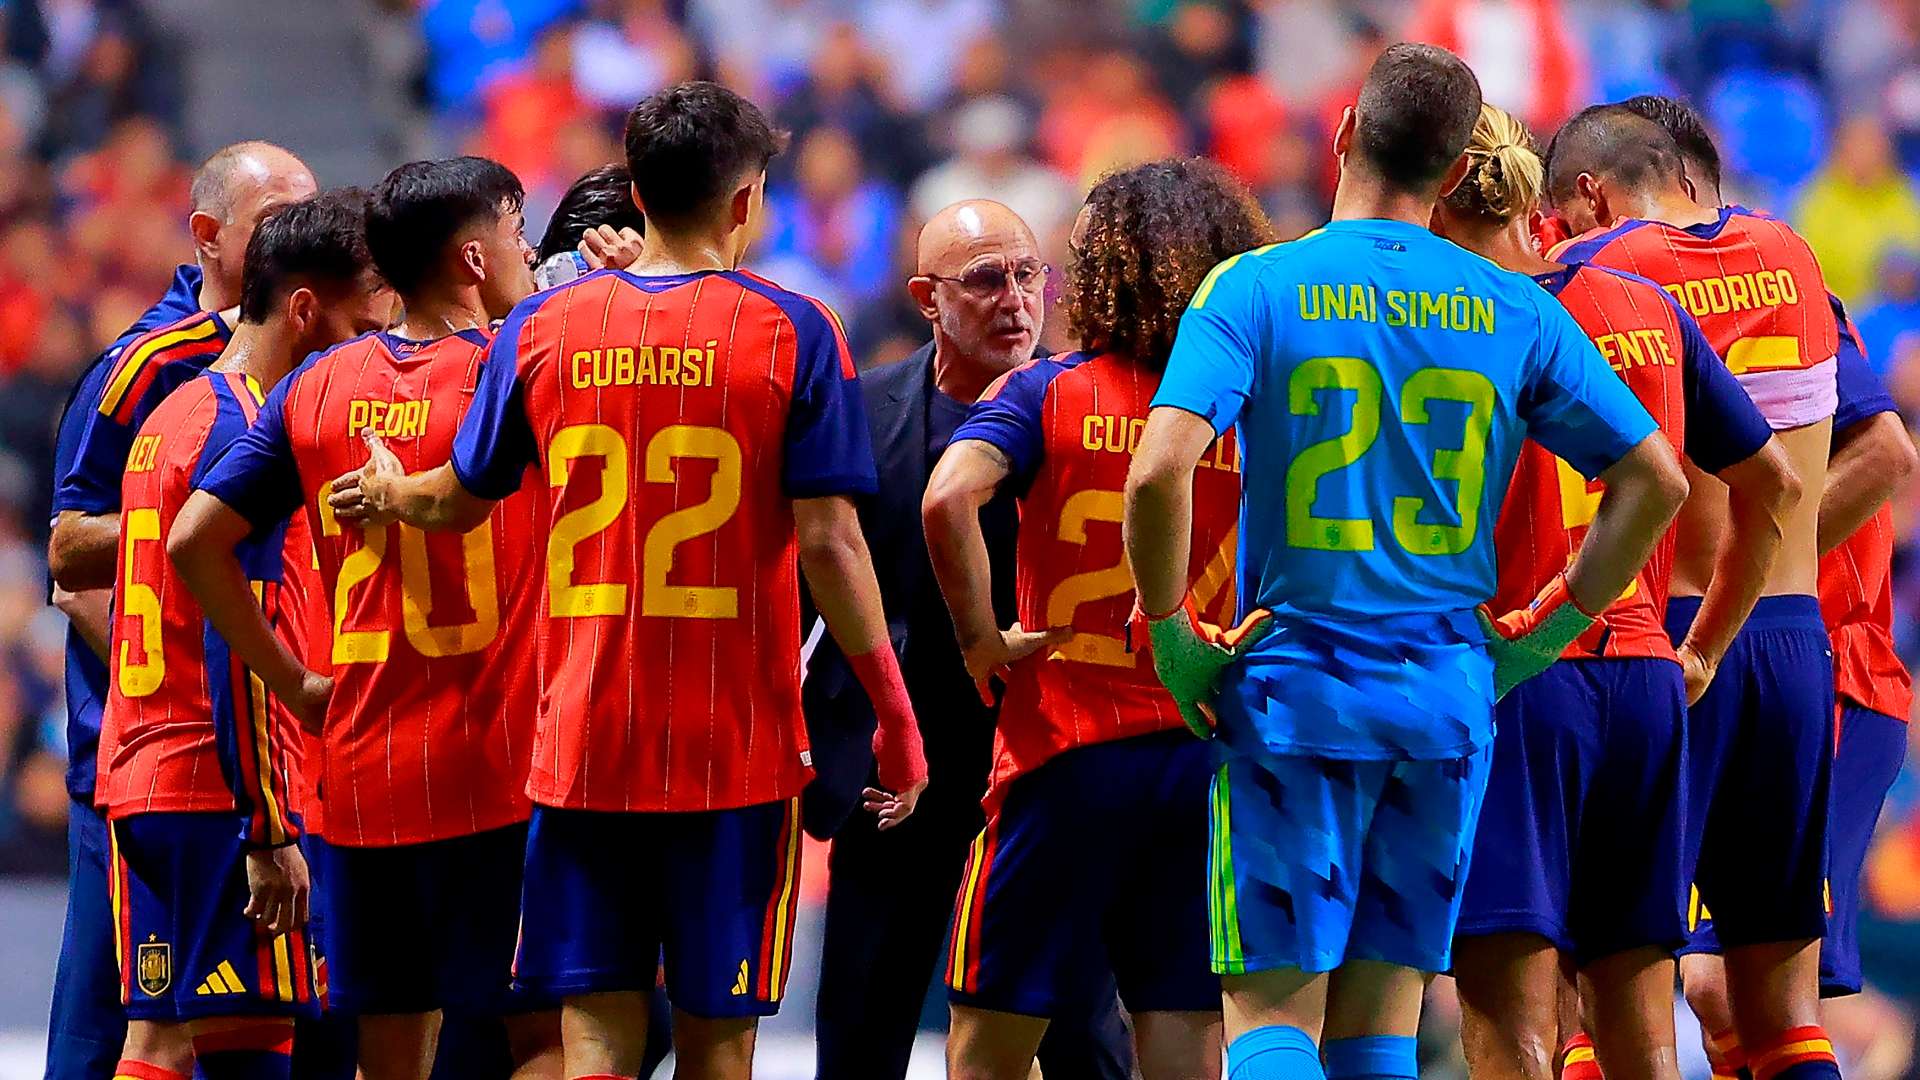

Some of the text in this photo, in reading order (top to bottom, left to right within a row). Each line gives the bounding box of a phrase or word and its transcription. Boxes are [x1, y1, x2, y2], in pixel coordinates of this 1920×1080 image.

[1297, 283, 1495, 335] UNAI SIMÓN
[572, 340, 718, 389] CUBARSÍ
[1595, 328, 1676, 371] ENTE
[348, 399, 432, 438] PEDRI
[1284, 356, 1497, 556] 23
[547, 424, 742, 619] 22
[318, 471, 500, 666] 20
